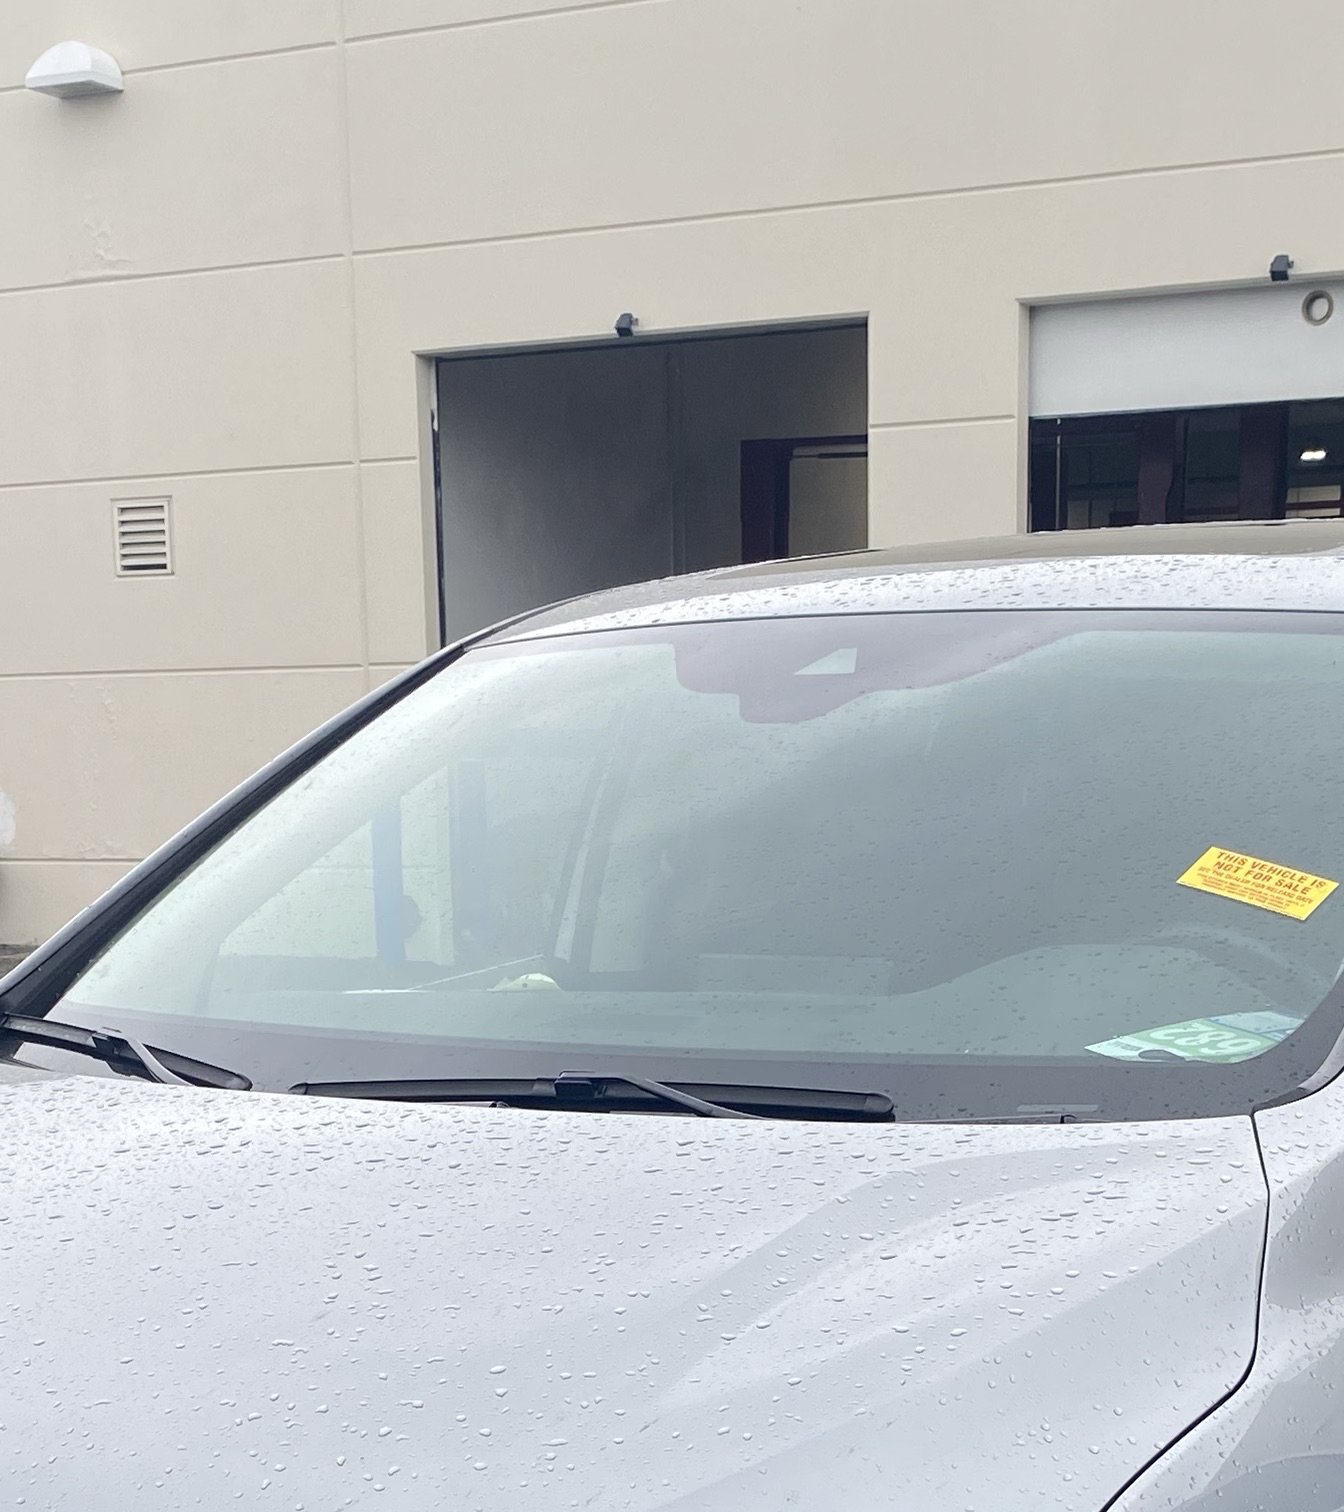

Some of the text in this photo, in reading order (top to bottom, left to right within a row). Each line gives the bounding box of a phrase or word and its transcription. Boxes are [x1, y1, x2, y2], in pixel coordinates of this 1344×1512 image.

[1214, 861, 1243, 873] NOT
[1244, 870, 1273, 882] FOR
[1275, 879, 1312, 895] SALE
[1217, 852, 1327, 888] THIS VEHICLE IS
[1149, 1022, 1261, 1055] 682
